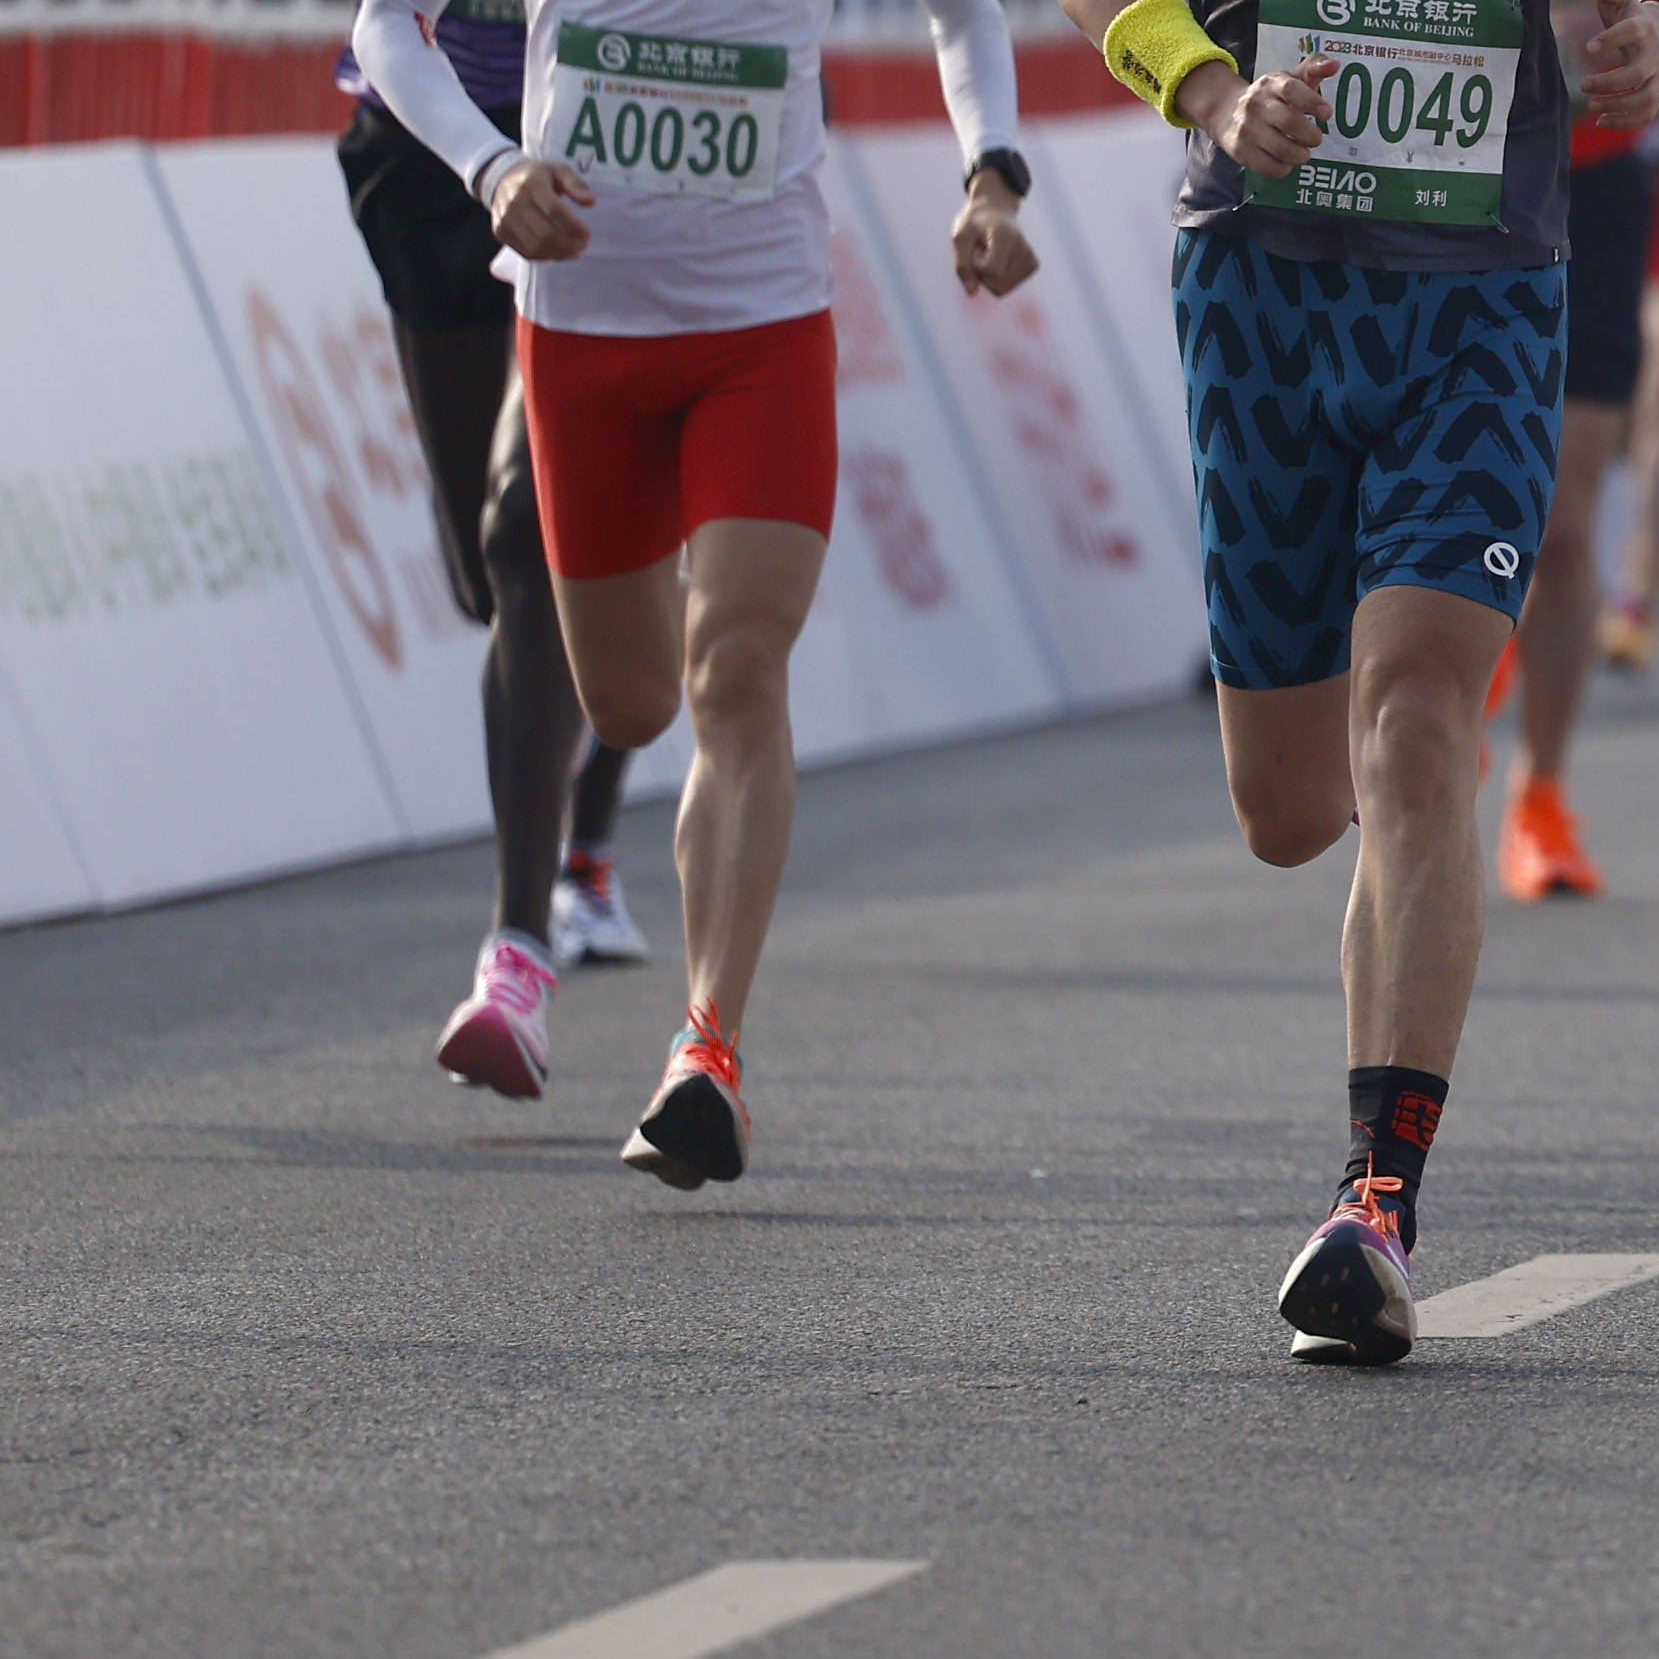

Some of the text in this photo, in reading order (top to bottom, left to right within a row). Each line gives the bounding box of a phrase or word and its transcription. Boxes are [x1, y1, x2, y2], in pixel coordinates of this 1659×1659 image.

[1363, 16, 1475, 38] BANK OF BEIJING
[1300, 57, 1493, 148] 0049
[565, 96, 758, 178] A0030
[1298, 164, 1377, 194] BEIAO
[1296, 189, 1374, 213] 北奥集团
[1415, 189, 1447, 207] 刘利
